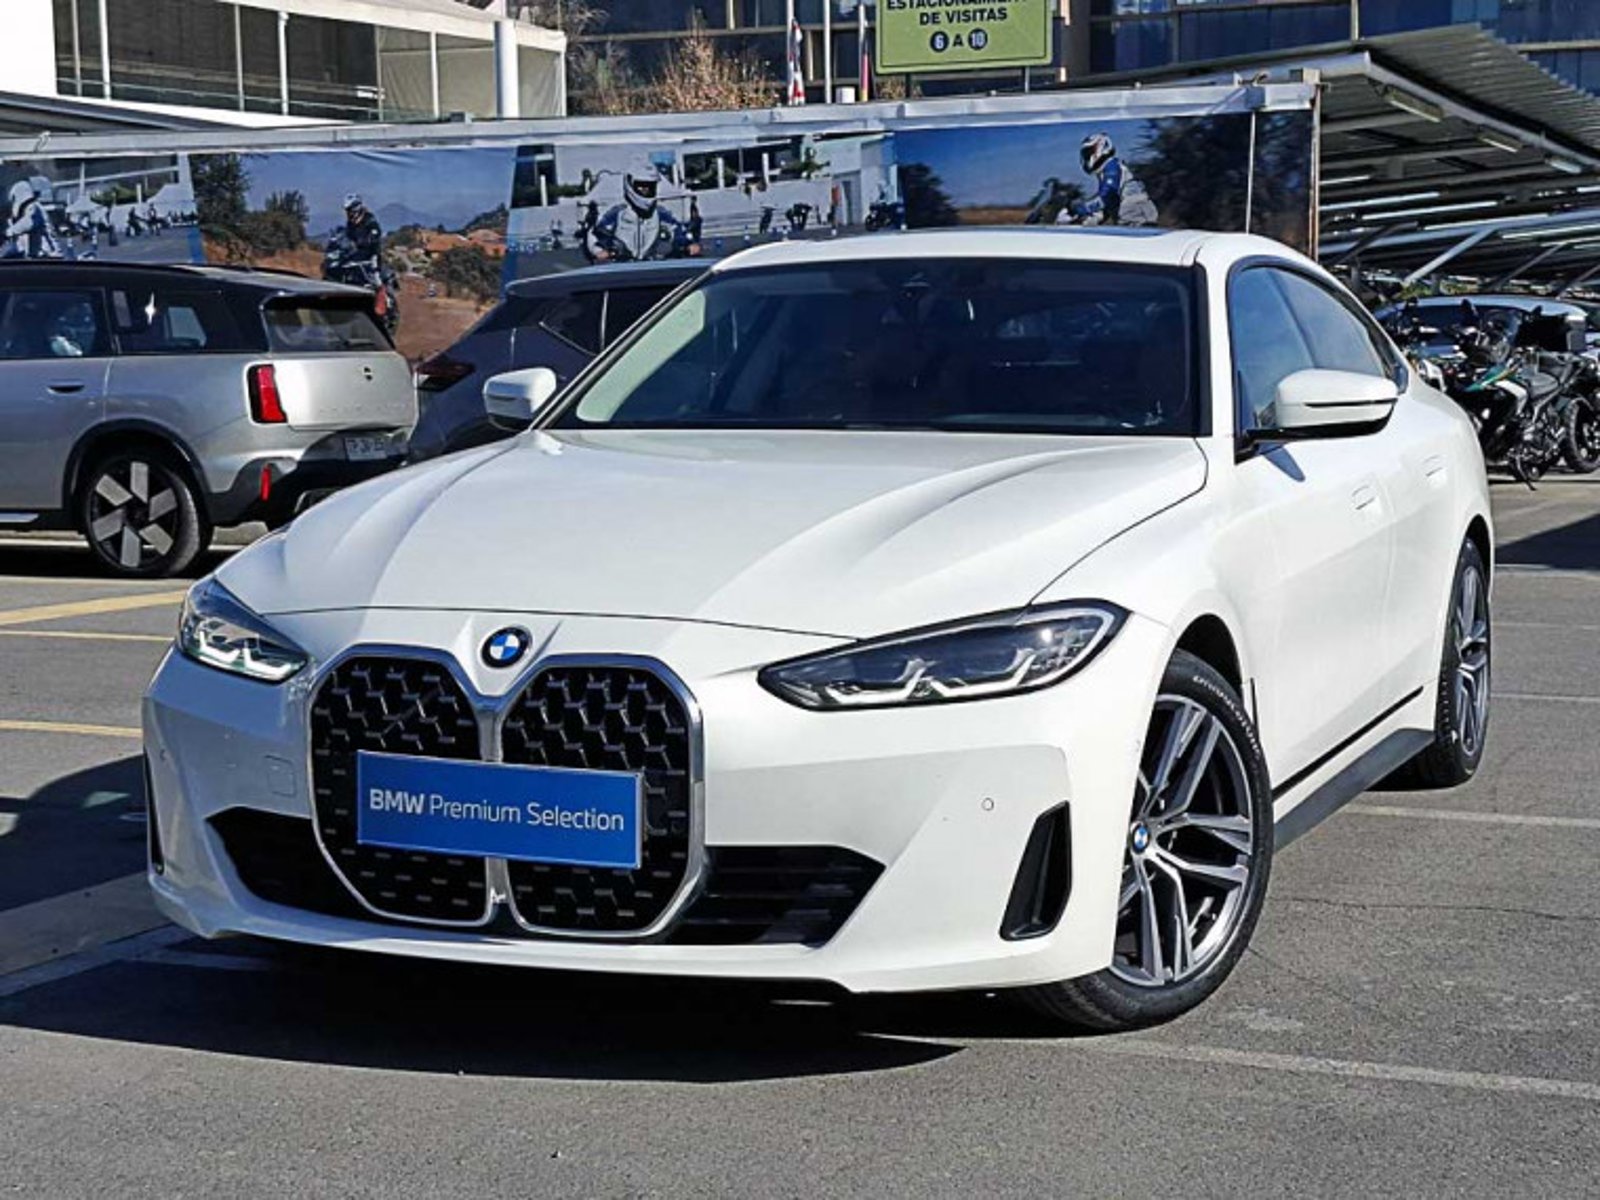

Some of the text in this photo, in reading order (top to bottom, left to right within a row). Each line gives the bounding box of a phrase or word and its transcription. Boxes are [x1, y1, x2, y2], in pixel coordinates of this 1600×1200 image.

[919, 7, 1008, 25] DE VISITAS
[934, 31, 986, 50] 6 A 10
[369, 788, 625, 831] BMW Premium Selection
